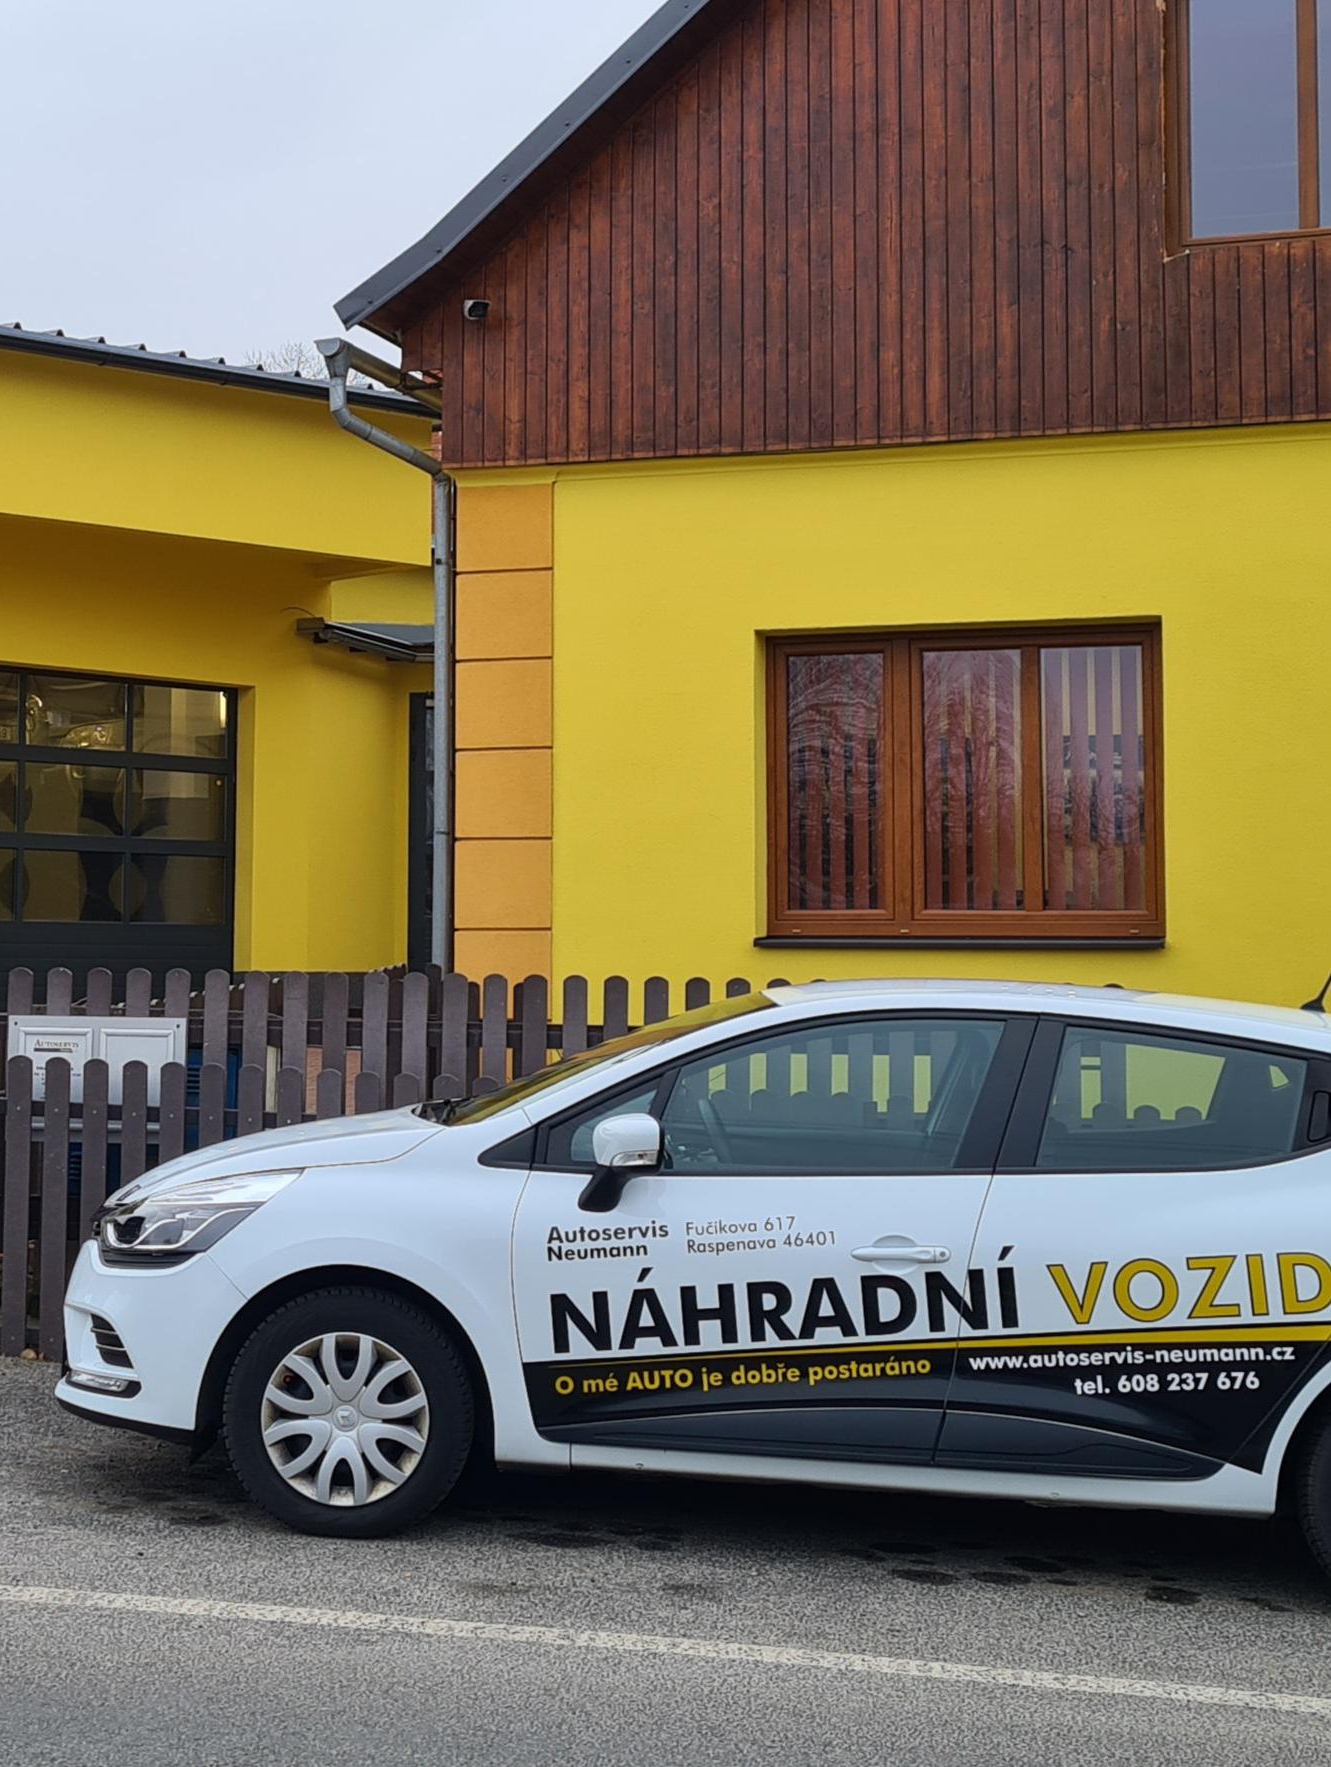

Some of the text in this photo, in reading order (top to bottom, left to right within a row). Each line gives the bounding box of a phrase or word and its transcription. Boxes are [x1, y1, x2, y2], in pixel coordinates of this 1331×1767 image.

[547, 1220, 669, 1245] Autoservis
[764, 1216, 796, 1232] 617
[547, 1244, 649, 1262] Neumann
[686, 1231, 836, 1256] Raspenava 46401
[549, 1245, 1331, 1354] NÁHRADNÍ VOZID
[969, 1346, 1296, 1371] www.autoservis-neumann.cz
[555, 1358, 931, 1395] O mé AUTO je dobře postaráno
[1074, 1371, 1260, 1396] tel. 608 237 676
